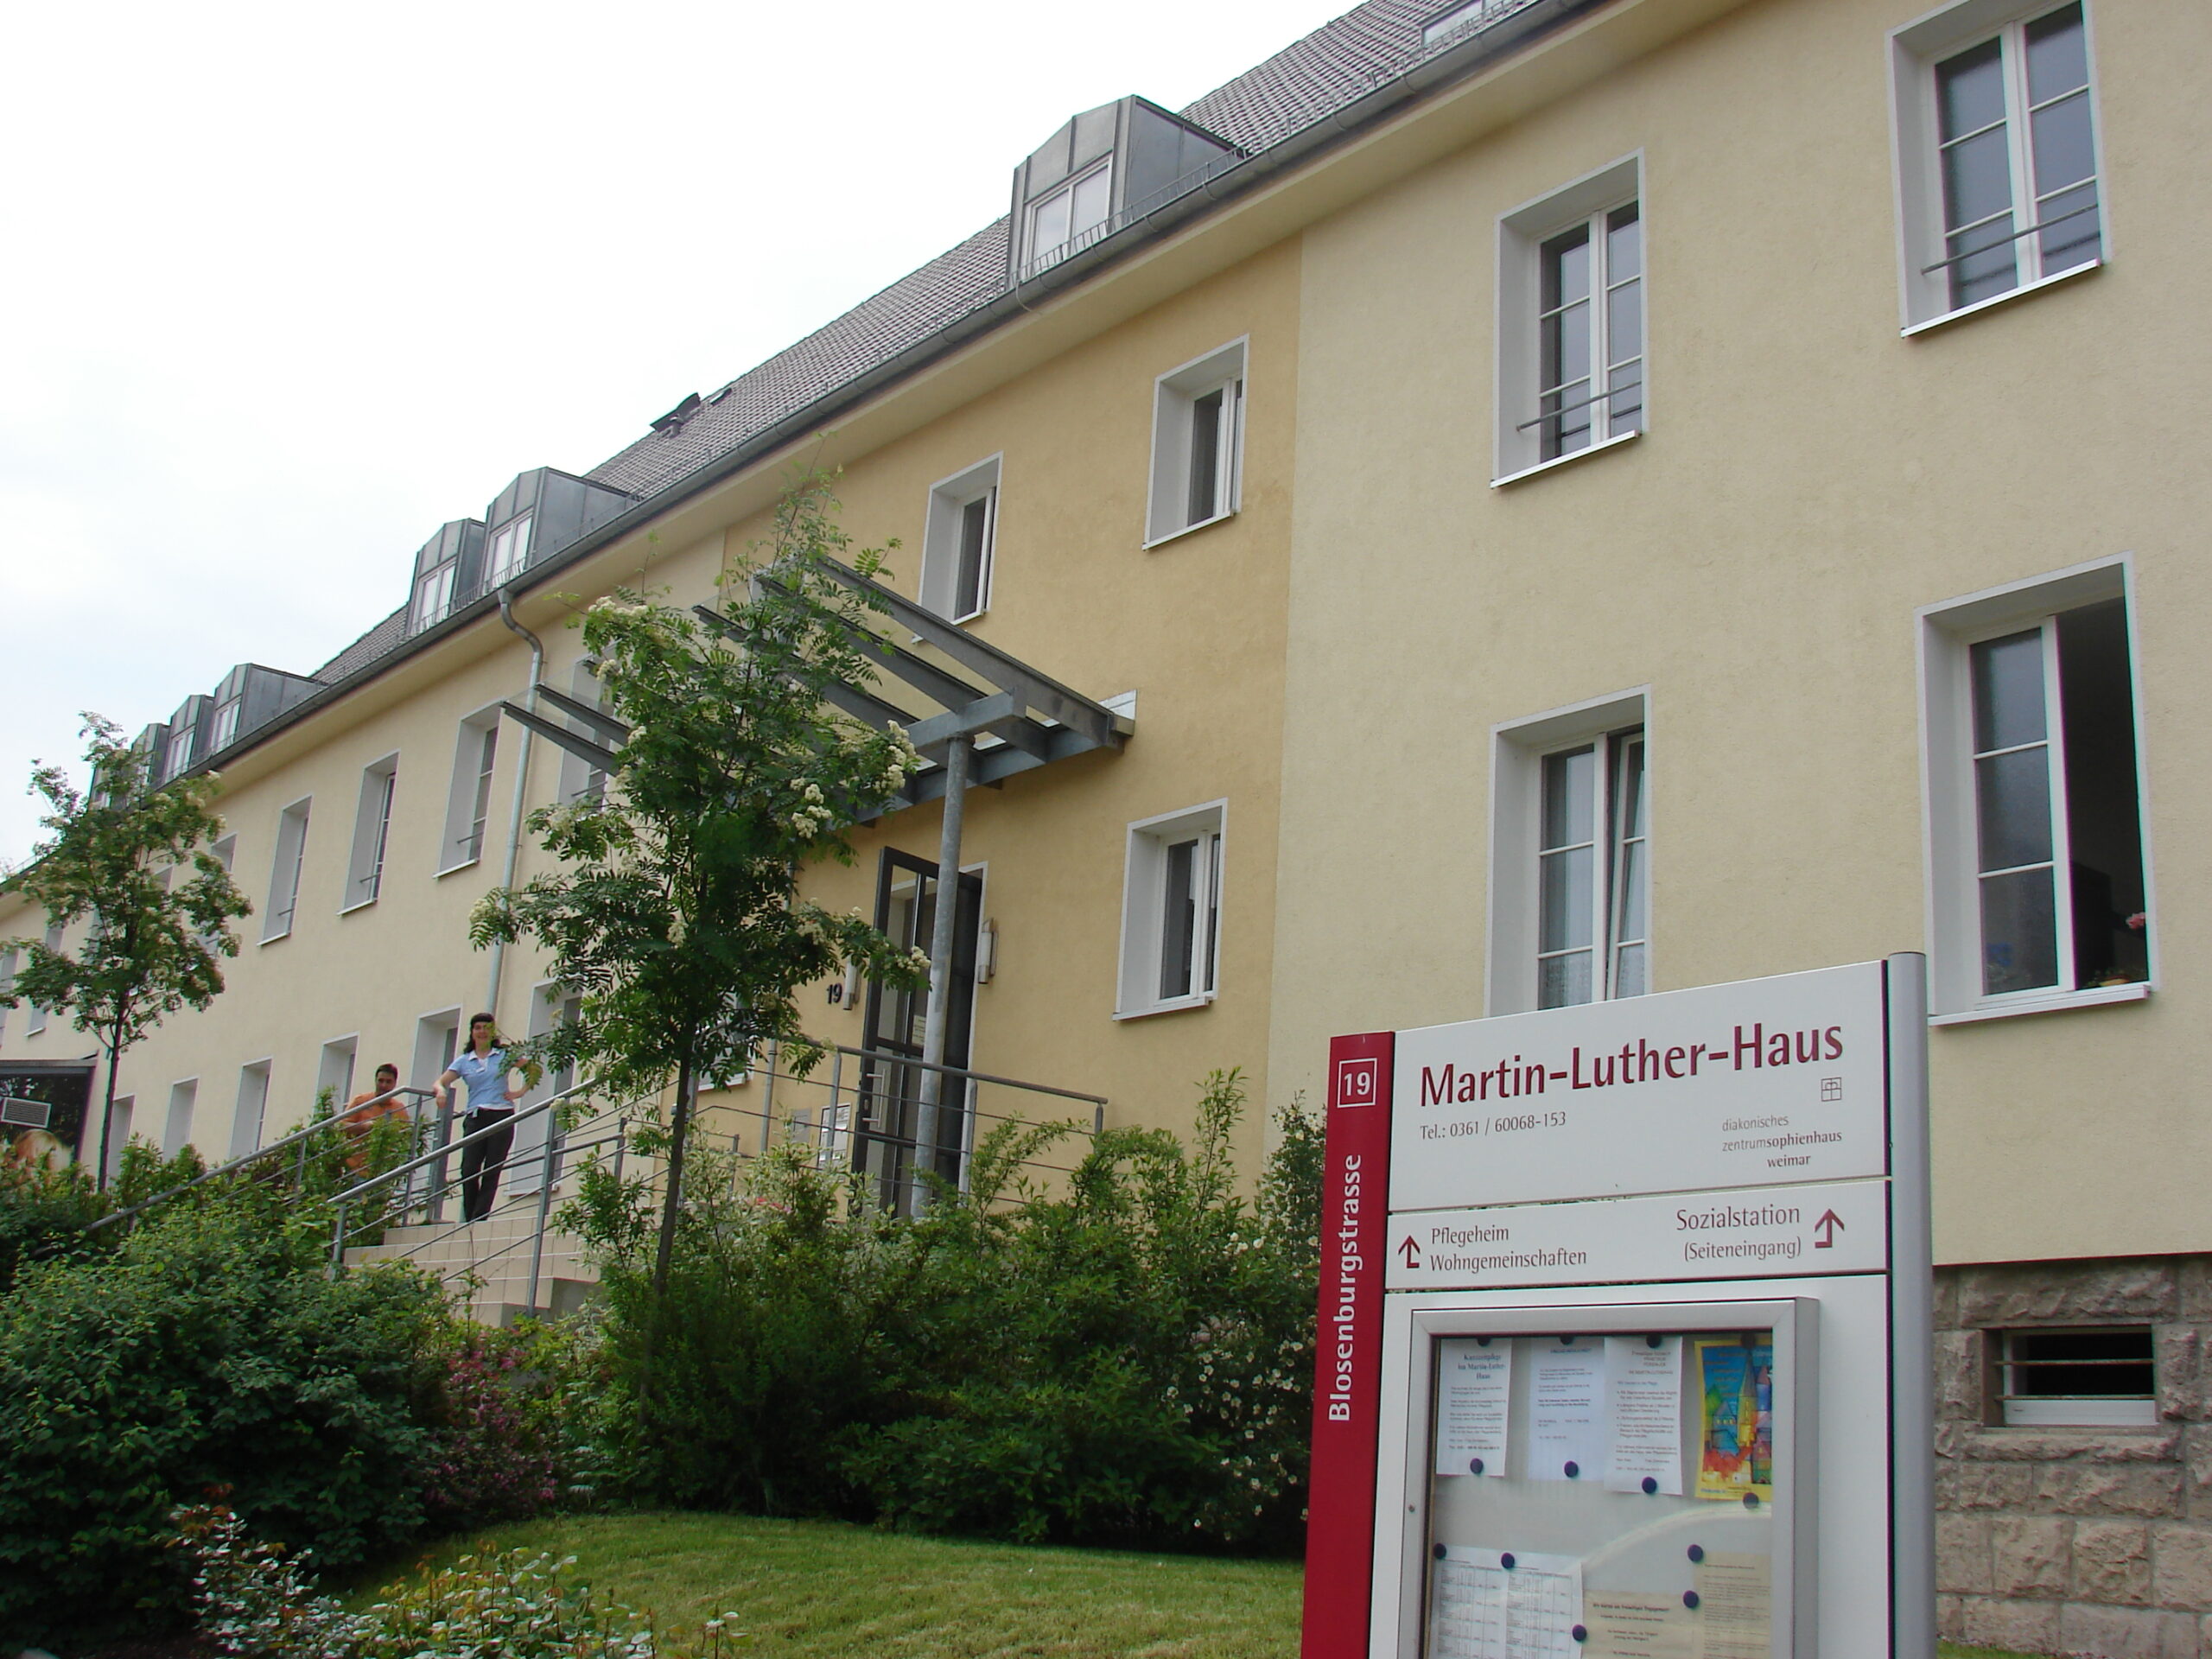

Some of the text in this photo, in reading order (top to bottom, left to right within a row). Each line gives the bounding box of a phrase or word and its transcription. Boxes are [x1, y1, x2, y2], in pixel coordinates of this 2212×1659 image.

[826, 982, 842, 1004] 19
[1421, 1022, 1844, 1107] Martin-Luther-Haus
[1343, 1071, 1371, 1096] 19
[1420, 1111, 1566, 1140] Tel.: 0361 / 60068-153
[1722, 1115, 1789, 1132] diakonisches
[1722, 1131, 1842, 1152] zentrumsophienhaus
[1767, 1154, 1811, 1167] weimar
[1676, 1204, 1800, 1230] Sozialstation
[1431, 1224, 1509, 1248] Pflegeheim
[1430, 1248, 1587, 1274] Wohngemeinschaften
[1684, 1236, 1802, 1262] (Seiteneingang)
[1329, 1154, 1363, 1421] Blosenburgstrasse
